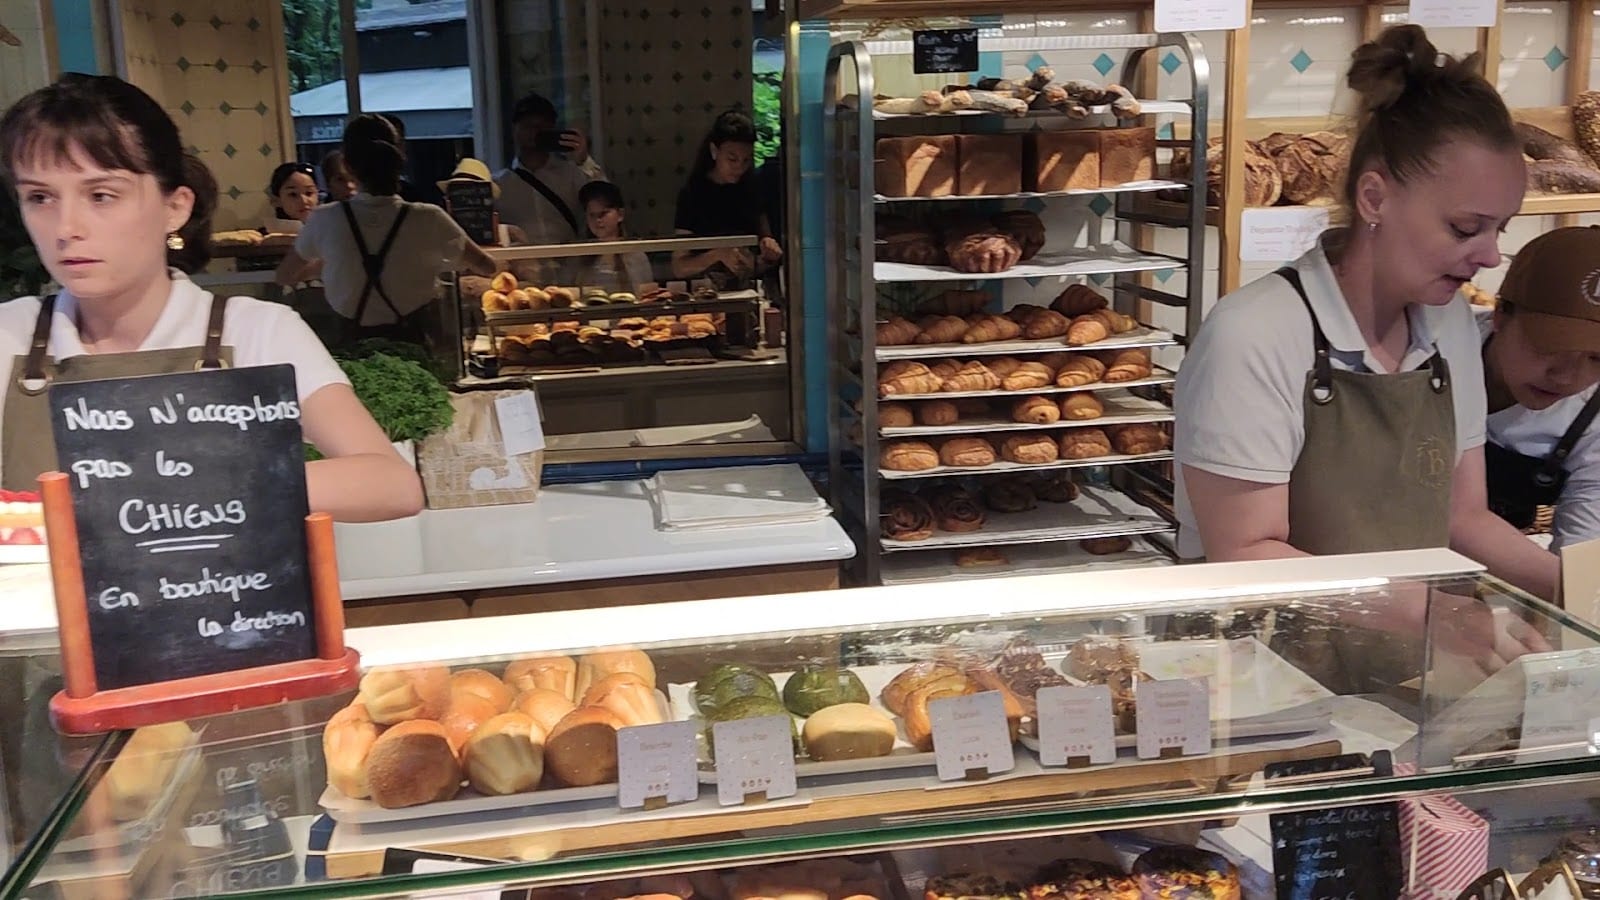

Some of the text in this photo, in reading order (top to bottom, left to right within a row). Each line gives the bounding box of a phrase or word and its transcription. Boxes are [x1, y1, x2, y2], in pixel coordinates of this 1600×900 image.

[63, 397, 134, 431] Nous
[71, 450, 194, 489] pas les
[99, 567, 272, 610] En boutique
[198, 609, 305, 637] la direction
